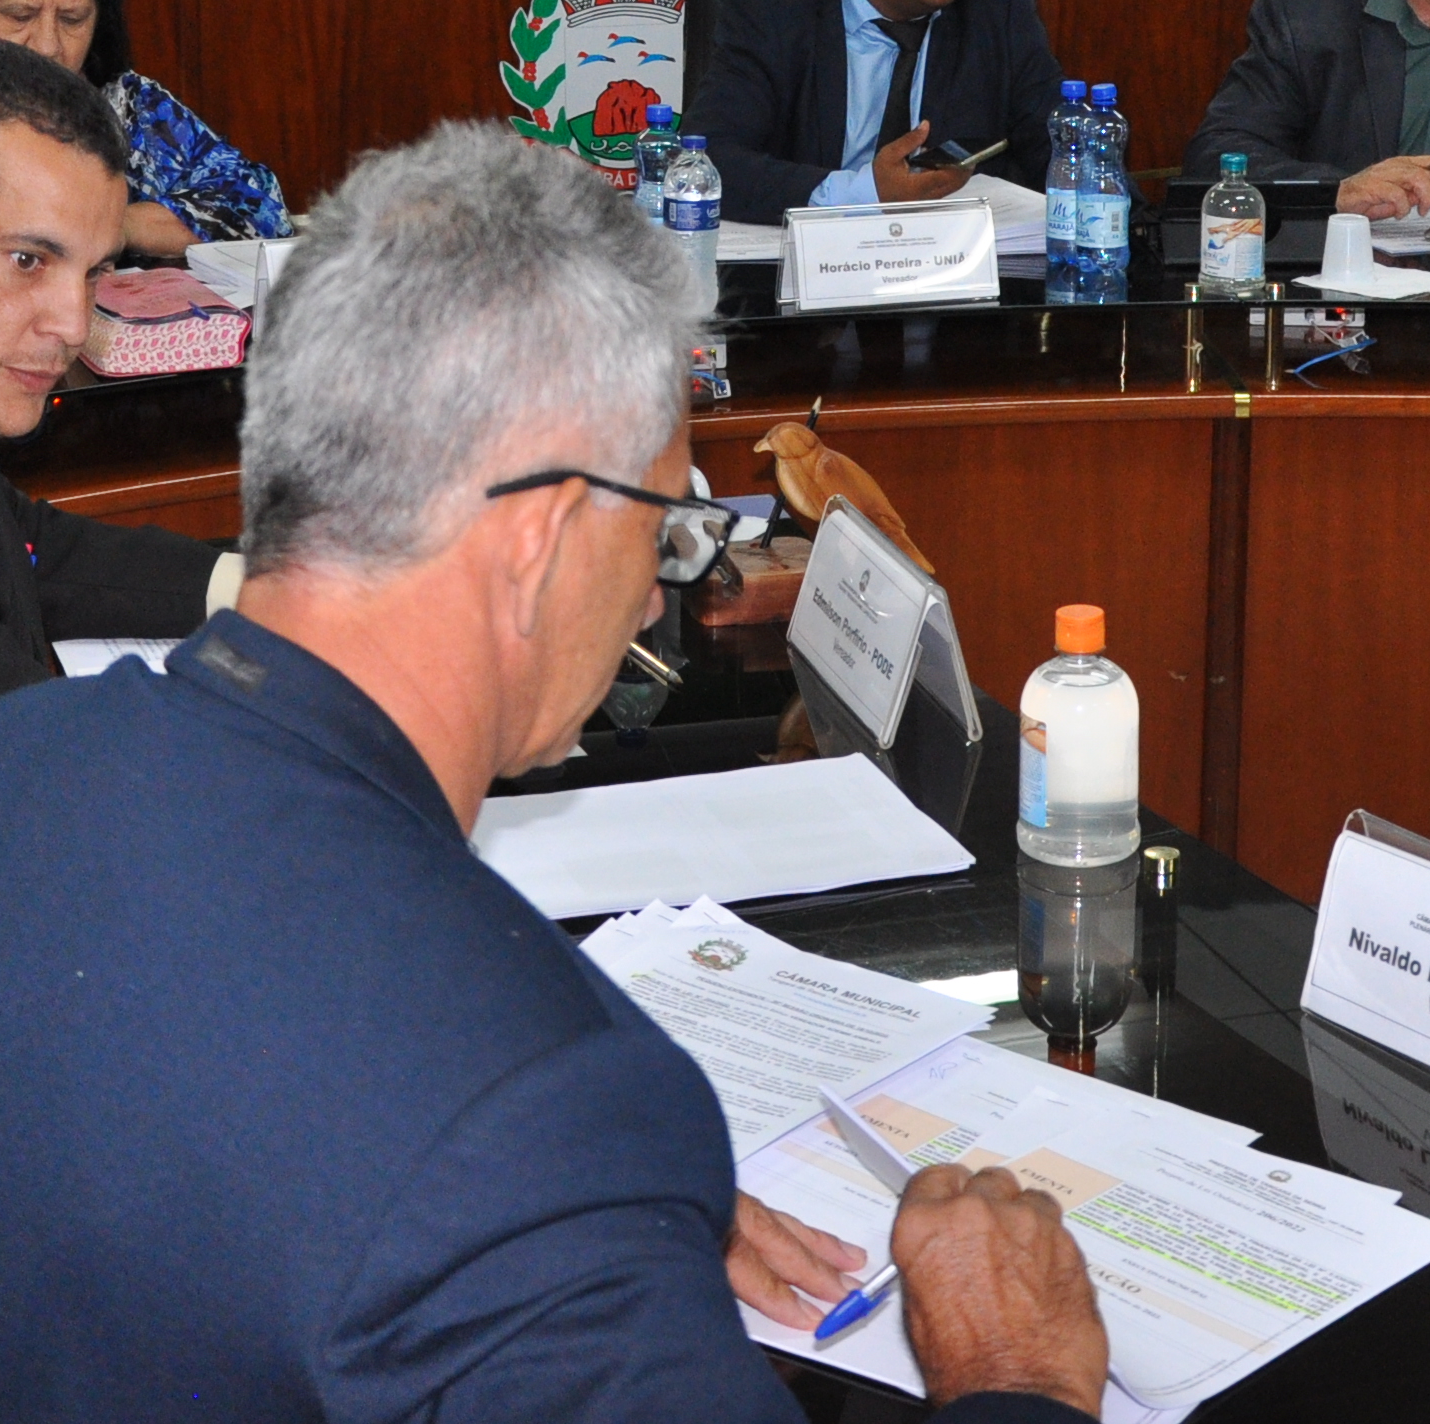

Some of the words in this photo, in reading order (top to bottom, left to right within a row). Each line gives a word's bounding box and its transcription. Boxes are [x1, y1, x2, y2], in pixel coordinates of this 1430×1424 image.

[819, 261, 870, 273] Horácio
[875, 258, 921, 270] Pereira
[935, 252, 970, 266] UNIÃ
[882, 274, 918, 284] Vereador
[871, 647, 894, 680] PODE
[1348, 927, 1423, 977] Nivaldo
[841, 990, 920, 1018] MUNICIPAL
[1020, 1168, 1074, 1195] EMENTA
